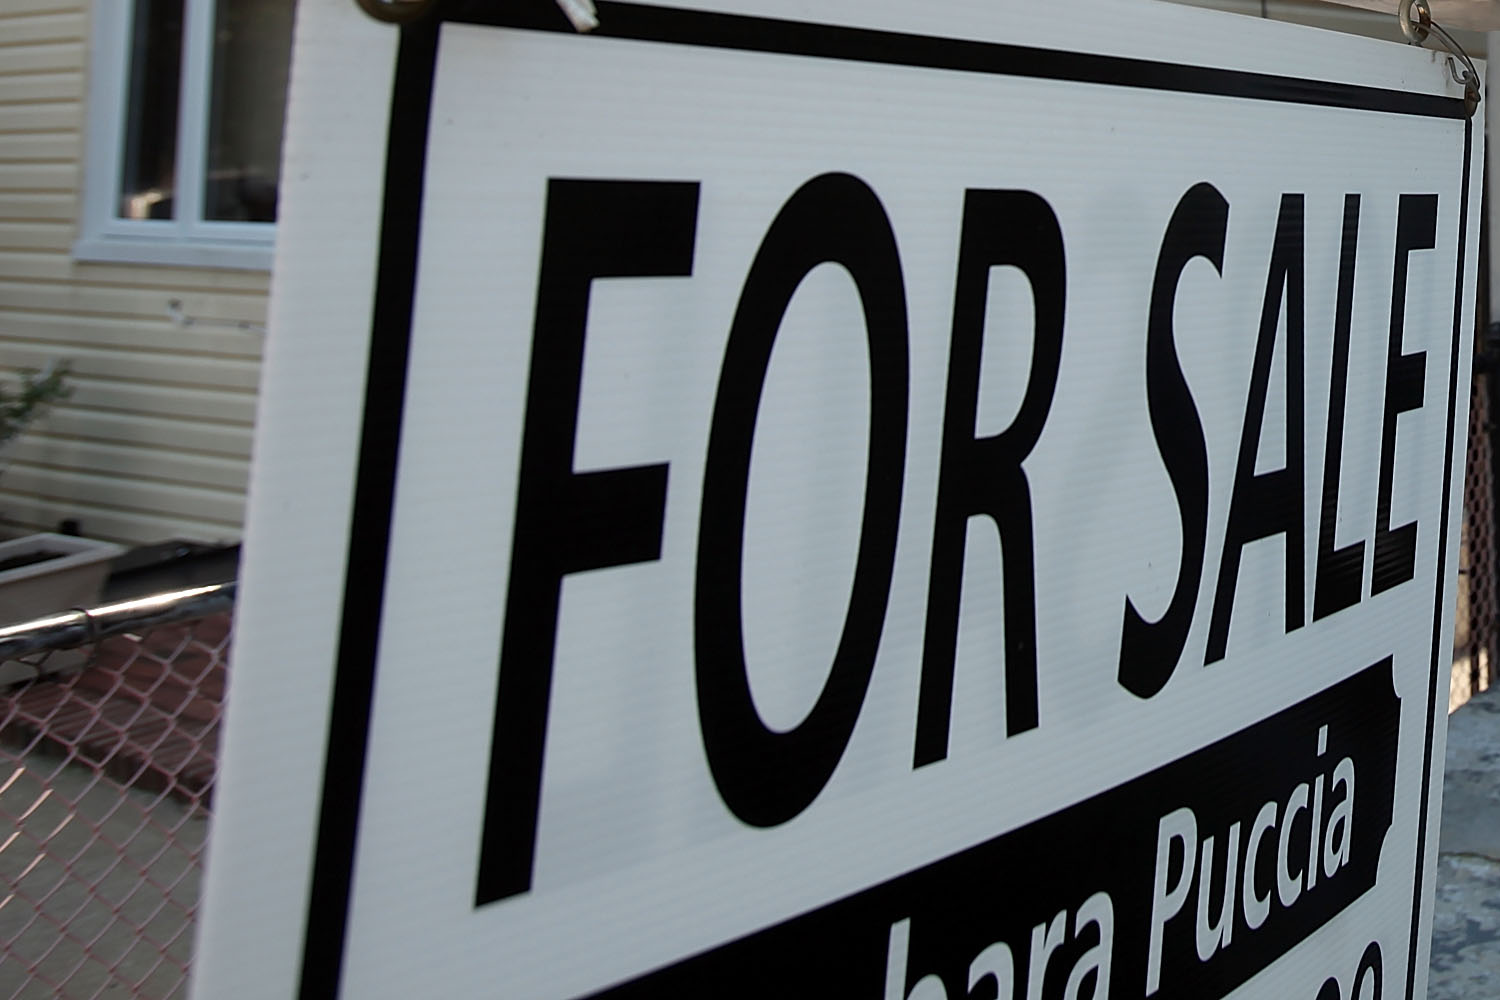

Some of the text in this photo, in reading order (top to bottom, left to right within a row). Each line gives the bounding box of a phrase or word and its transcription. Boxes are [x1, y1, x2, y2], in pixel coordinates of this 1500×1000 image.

[475, 172, 1438, 908] FOR SALE
[1146, 725, 1354, 996] Puccia
